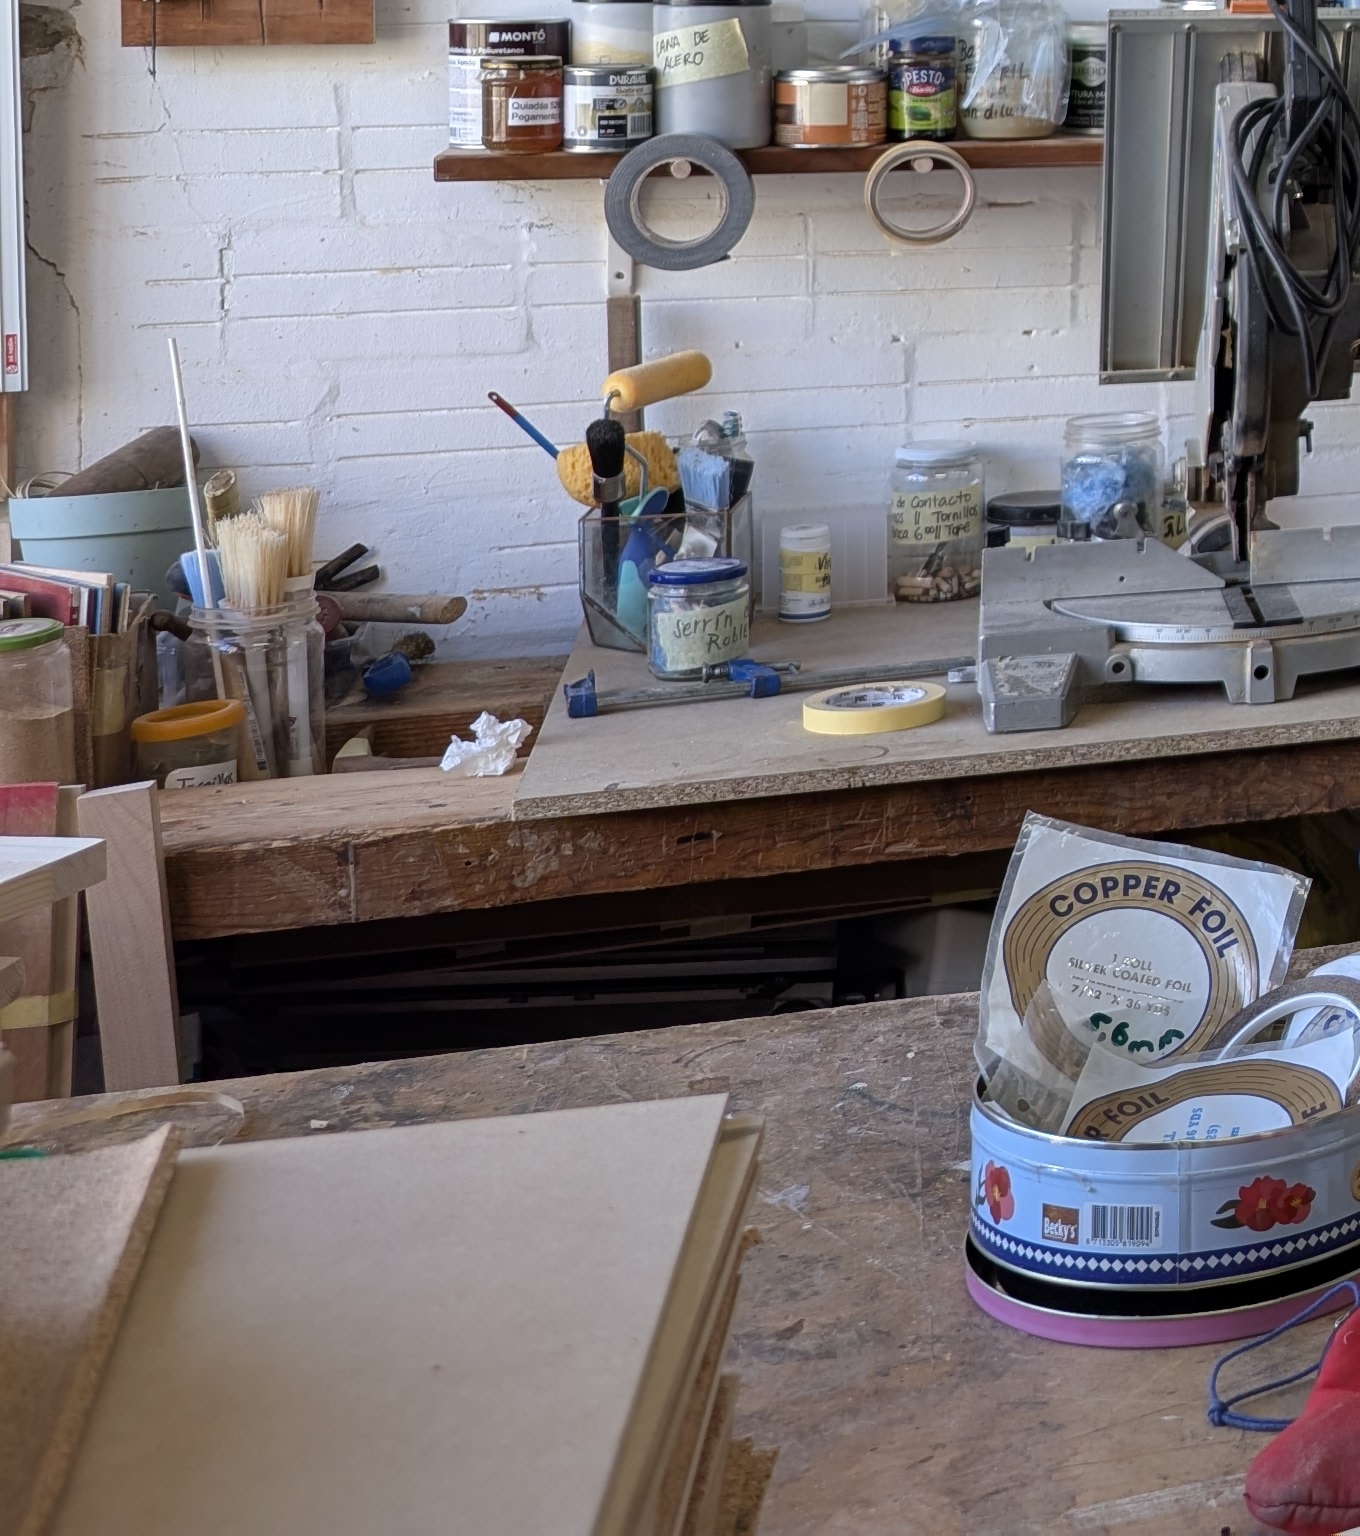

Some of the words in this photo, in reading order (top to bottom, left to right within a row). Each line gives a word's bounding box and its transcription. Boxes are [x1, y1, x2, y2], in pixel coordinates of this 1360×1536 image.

[501, 29, 546, 42] MONTÓ
[656, 35, 681, 58] LANA
[694, 29, 710, 47] DE
[664, 51, 704, 75] ACERO
[905, 70, 942, 83] PESTO
[911, 490, 972, 508] Contacto
[931, 504, 978, 524] Tornillos
[1050, 874, 1181, 917] COPPER
[1188, 896, 1239, 959] FOIL
[1112, 969, 1161, 988] COATED
[1165, 979, 1193, 994] FOIL
[1103, 1090, 1170, 1127] FOIL
[1187, 1107, 1203, 1128] YDS
[1043, 1217, 1079, 1242] Becky's
